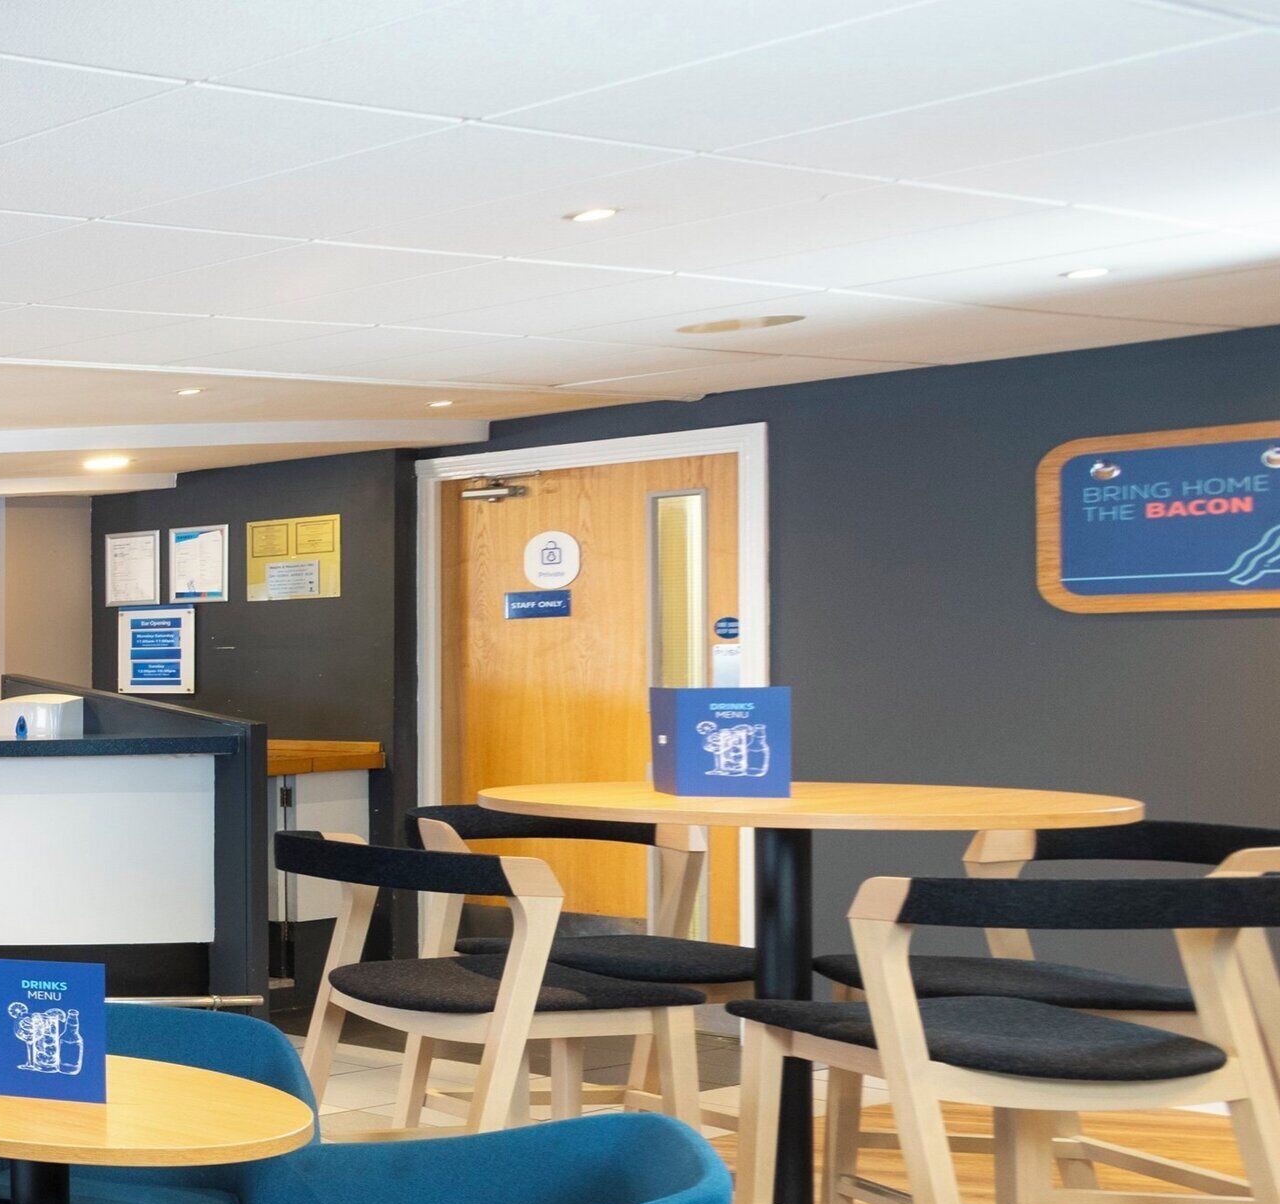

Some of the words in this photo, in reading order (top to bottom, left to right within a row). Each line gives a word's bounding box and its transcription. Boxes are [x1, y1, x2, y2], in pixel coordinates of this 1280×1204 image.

[1083, 481, 1170, 503] BRING
[1182, 475, 1270, 496] HOME
[1083, 504, 1136, 522] THE
[1145, 497, 1254, 519] BACON
[538, 600, 563, 608] ONLY
[709, 702, 755, 711] DRINKS
[715, 711, 750, 719] MENU
[21, 979, 68, 991] DRINKS
[27, 990, 62, 1001] MENU
